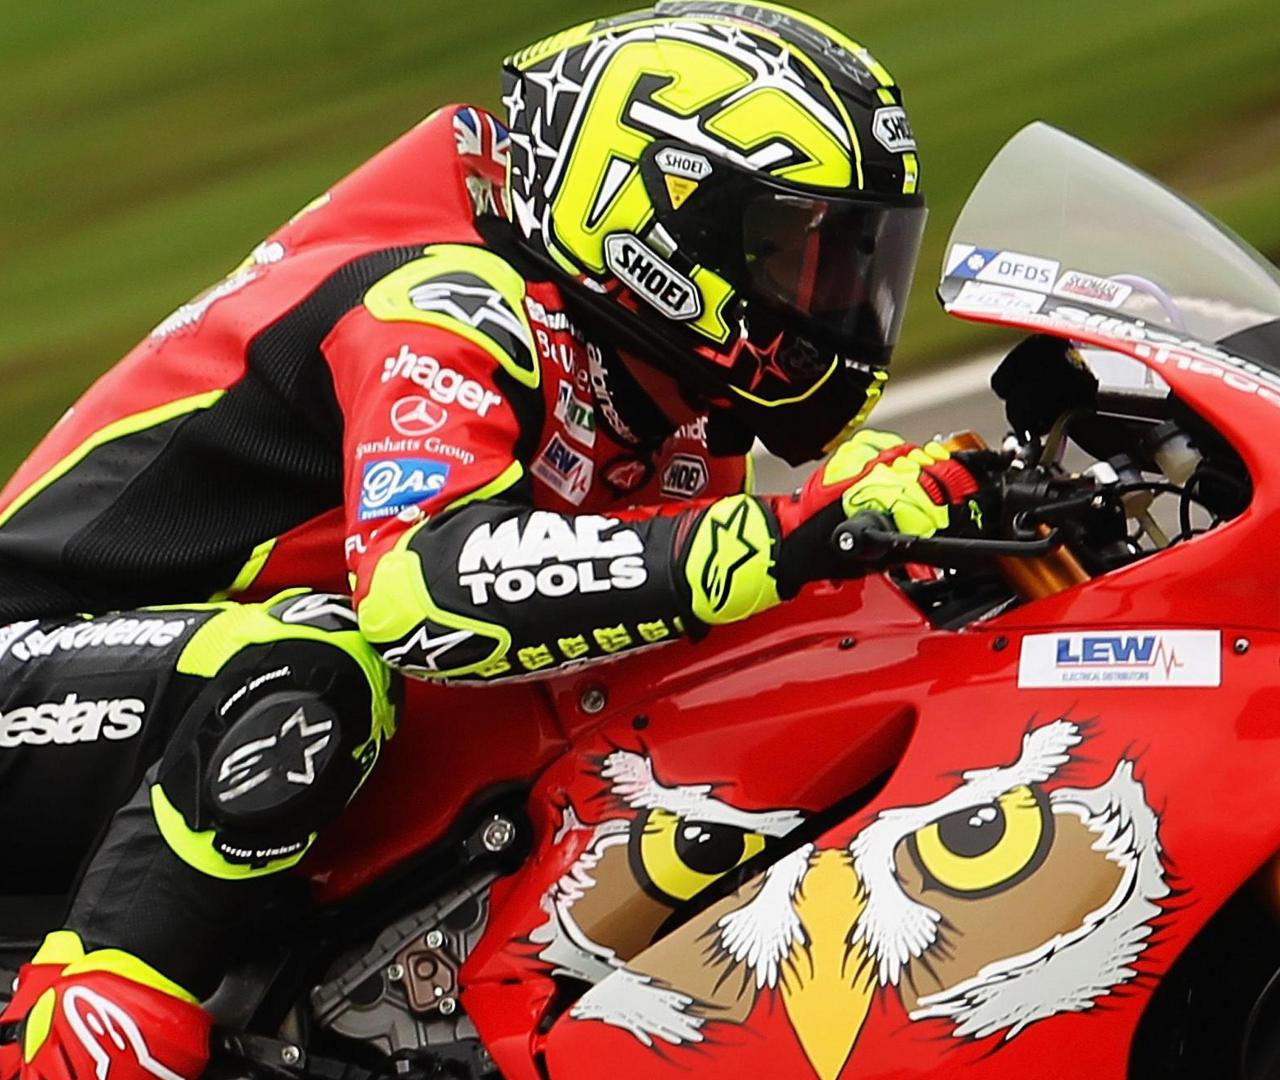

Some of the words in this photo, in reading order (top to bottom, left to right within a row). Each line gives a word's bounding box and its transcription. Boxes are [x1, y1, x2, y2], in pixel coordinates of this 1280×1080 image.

[665, 154, 704, 175] SHOEI
[615, 243, 691, 315] SHOEI
[997, 260, 1050, 283] DFDS
[380, 345, 503, 418] :hager
[423, 436, 475, 465] Group
[458, 511, 645, 575] MAC
[458, 555, 648, 606] TOOLS
[1055, 636, 1157, 664] LEW
